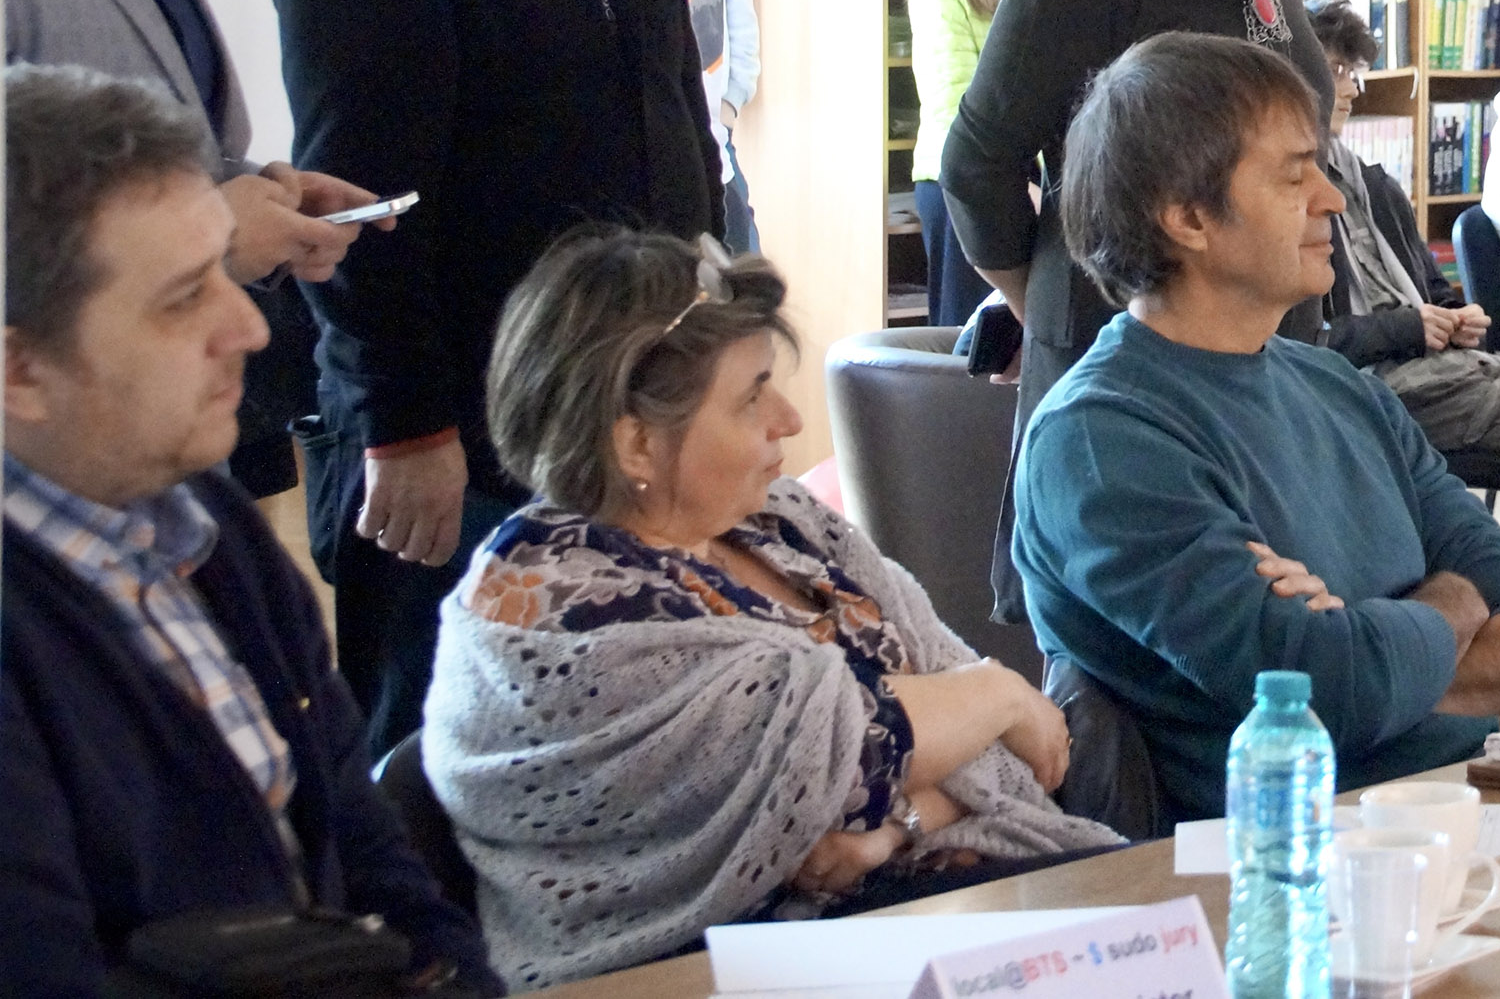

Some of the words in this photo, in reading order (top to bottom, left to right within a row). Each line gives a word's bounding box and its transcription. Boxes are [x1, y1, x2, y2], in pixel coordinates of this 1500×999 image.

[951, 949, 1068, 996] local@BTS
[1106, 932, 1158, 962] sudo
[1160, 924, 1198, 954] jury
